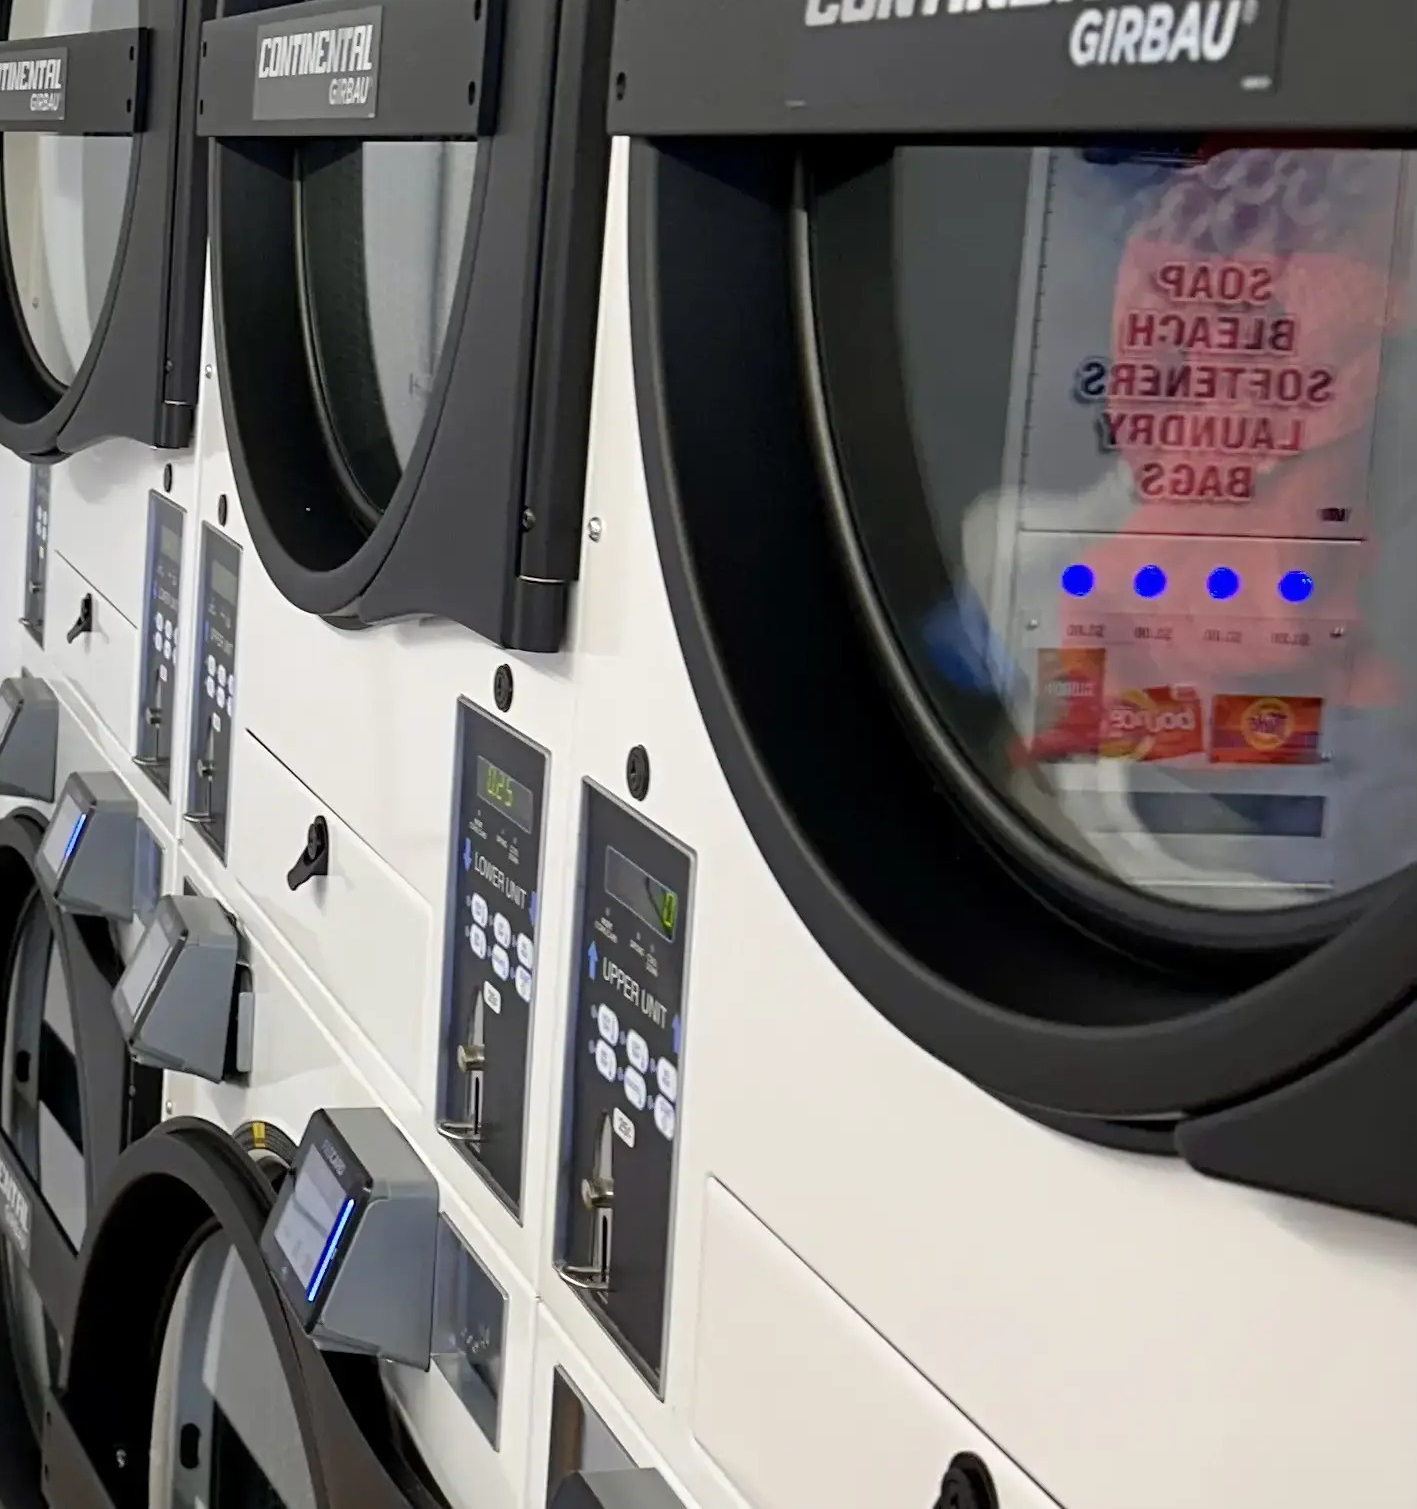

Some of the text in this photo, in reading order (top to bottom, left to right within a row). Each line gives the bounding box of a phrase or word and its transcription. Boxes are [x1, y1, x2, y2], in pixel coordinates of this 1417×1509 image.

[258, 24, 373, 78] CONTINENTAL
[475, 851, 505, 894] LOWER
[505, 876, 527, 910] UNIT
[602, 956, 640, 1007] UPPER
[640, 989, 668, 1029] UNIT
